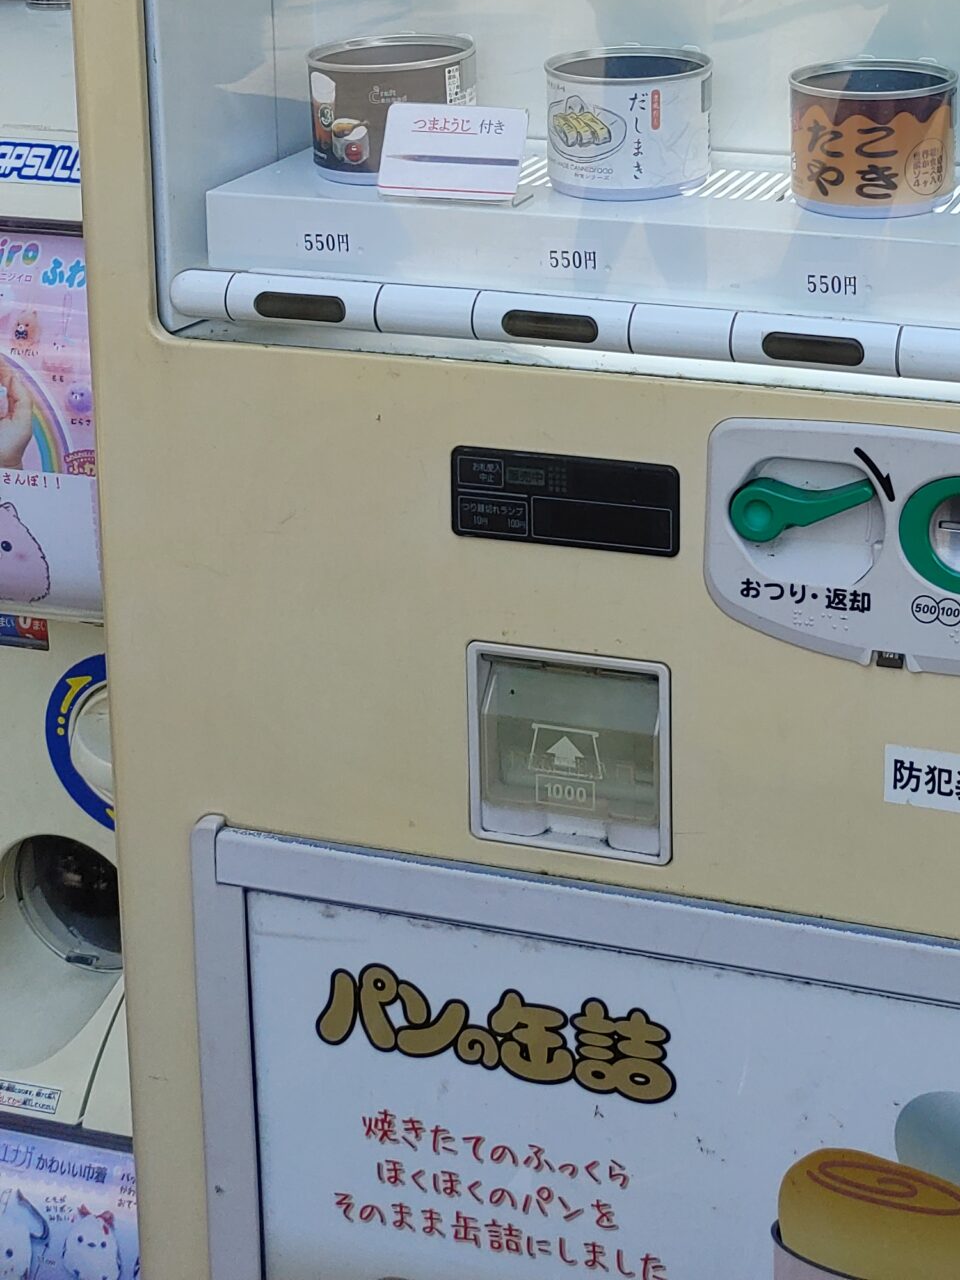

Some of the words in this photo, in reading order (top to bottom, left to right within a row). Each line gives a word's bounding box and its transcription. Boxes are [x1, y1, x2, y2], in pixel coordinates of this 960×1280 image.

[413, 117, 472, 133] つまようじ
[479, 119, 506, 135] 付き
[629, 93, 648, 180] だしまき
[304, 233, 350, 252] 550円
[549, 250, 597, 271] 550円
[807, 274, 857, 296] 550円
[740, 578, 871, 614] おつり・返却
[914, 603, 937, 616] 500
[940, 606, 960, 619] 100
[543, 782, 587, 803] 1000
[316, 963, 677, 1104] パンの缶詰
[362, 1109, 631, 1190] 焼きたてのふっくら
[376, 1159, 620, 1231] ほくほくのパンを
[334, 1192, 670, 1280] そのまま缶詰にしました
